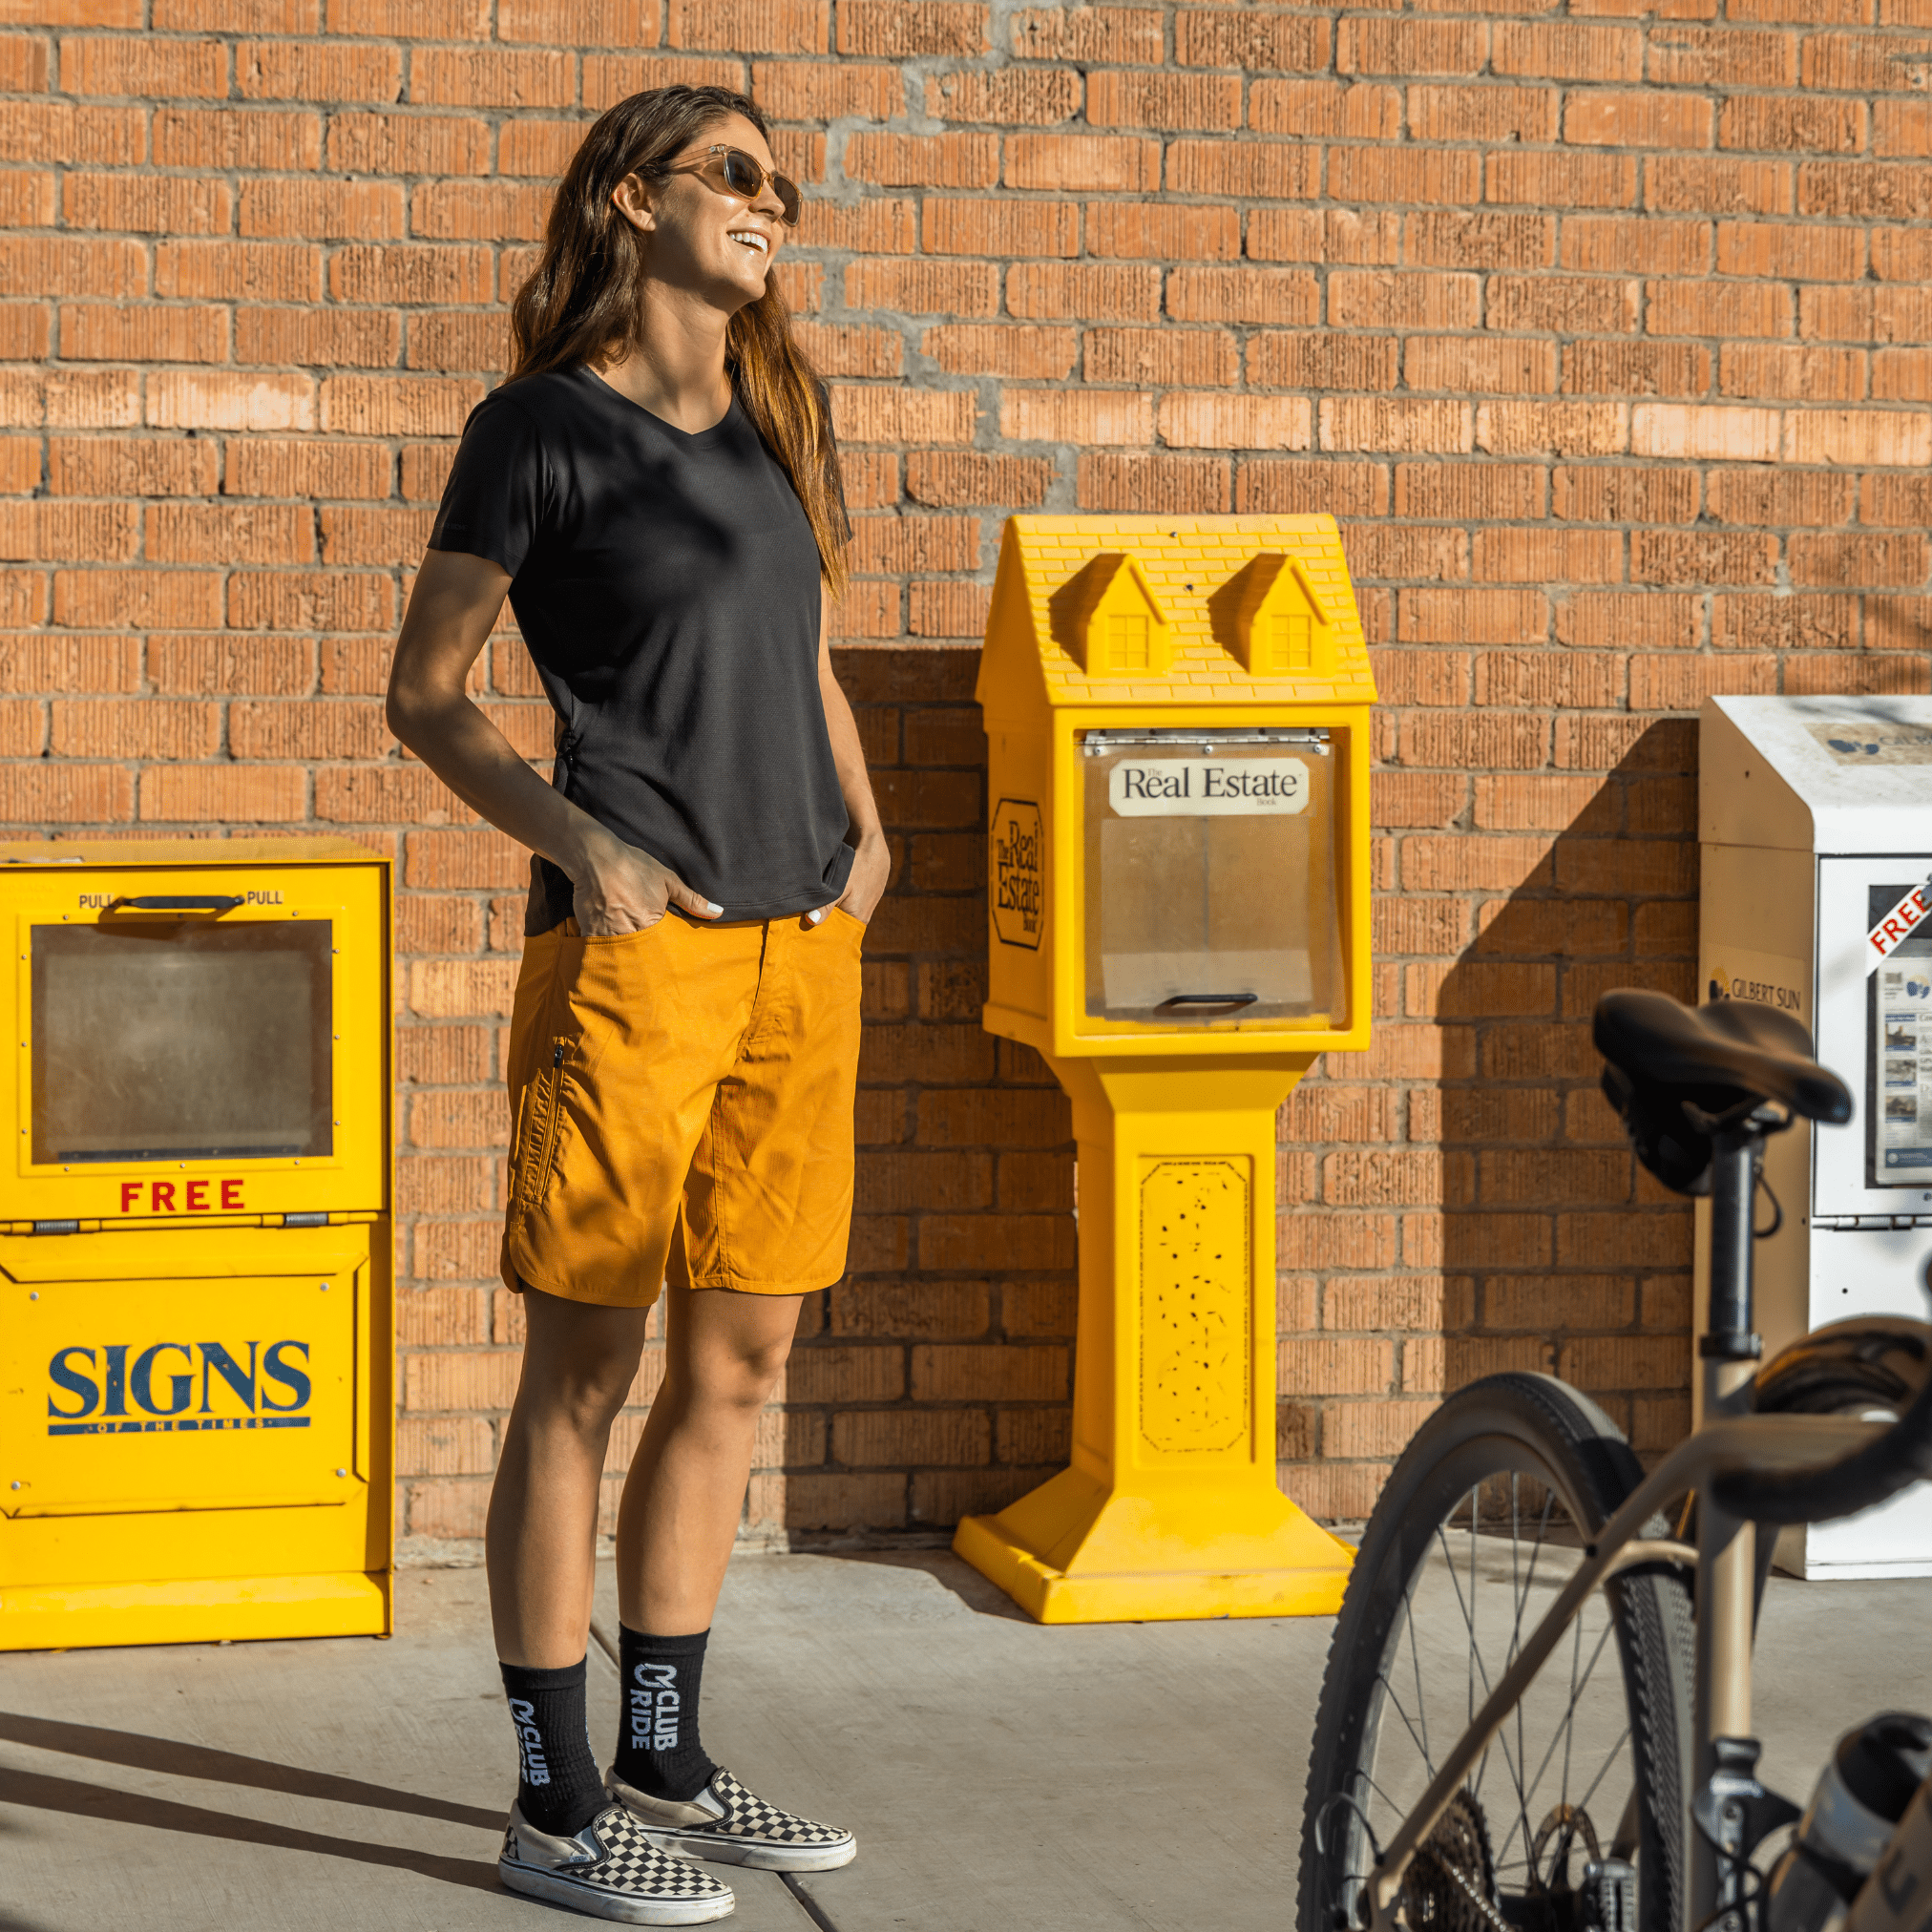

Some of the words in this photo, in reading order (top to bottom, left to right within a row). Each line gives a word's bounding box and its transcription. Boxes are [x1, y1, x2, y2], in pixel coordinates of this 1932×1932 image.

[1123, 766, 1190, 799] Real
[1202, 767, 1297, 798] Estate
[1147, 767, 1162, 777] The
[1256, 797, 1277, 807] Book
[1009, 820, 1038, 872] Real
[78, 893, 113, 909] PULL
[246, 891, 284, 905] PULL
[998, 861, 1040, 915] Estate
[1732, 978, 1774, 1004] GILBERT
[1776, 987, 1801, 1010] SUN
[120, 1179, 245, 1212] FREE
[48, 1340, 311, 1419] SIGNS
[97, 1421, 122, 1434] OF
[139, 1419, 179, 1432] THE
[196, 1418, 263, 1430] TIMES
[630, 1689, 652, 1750] RIDE
[654, 1690, 681, 1751] CLUB
[523, 1726, 551, 1786] CLUB
